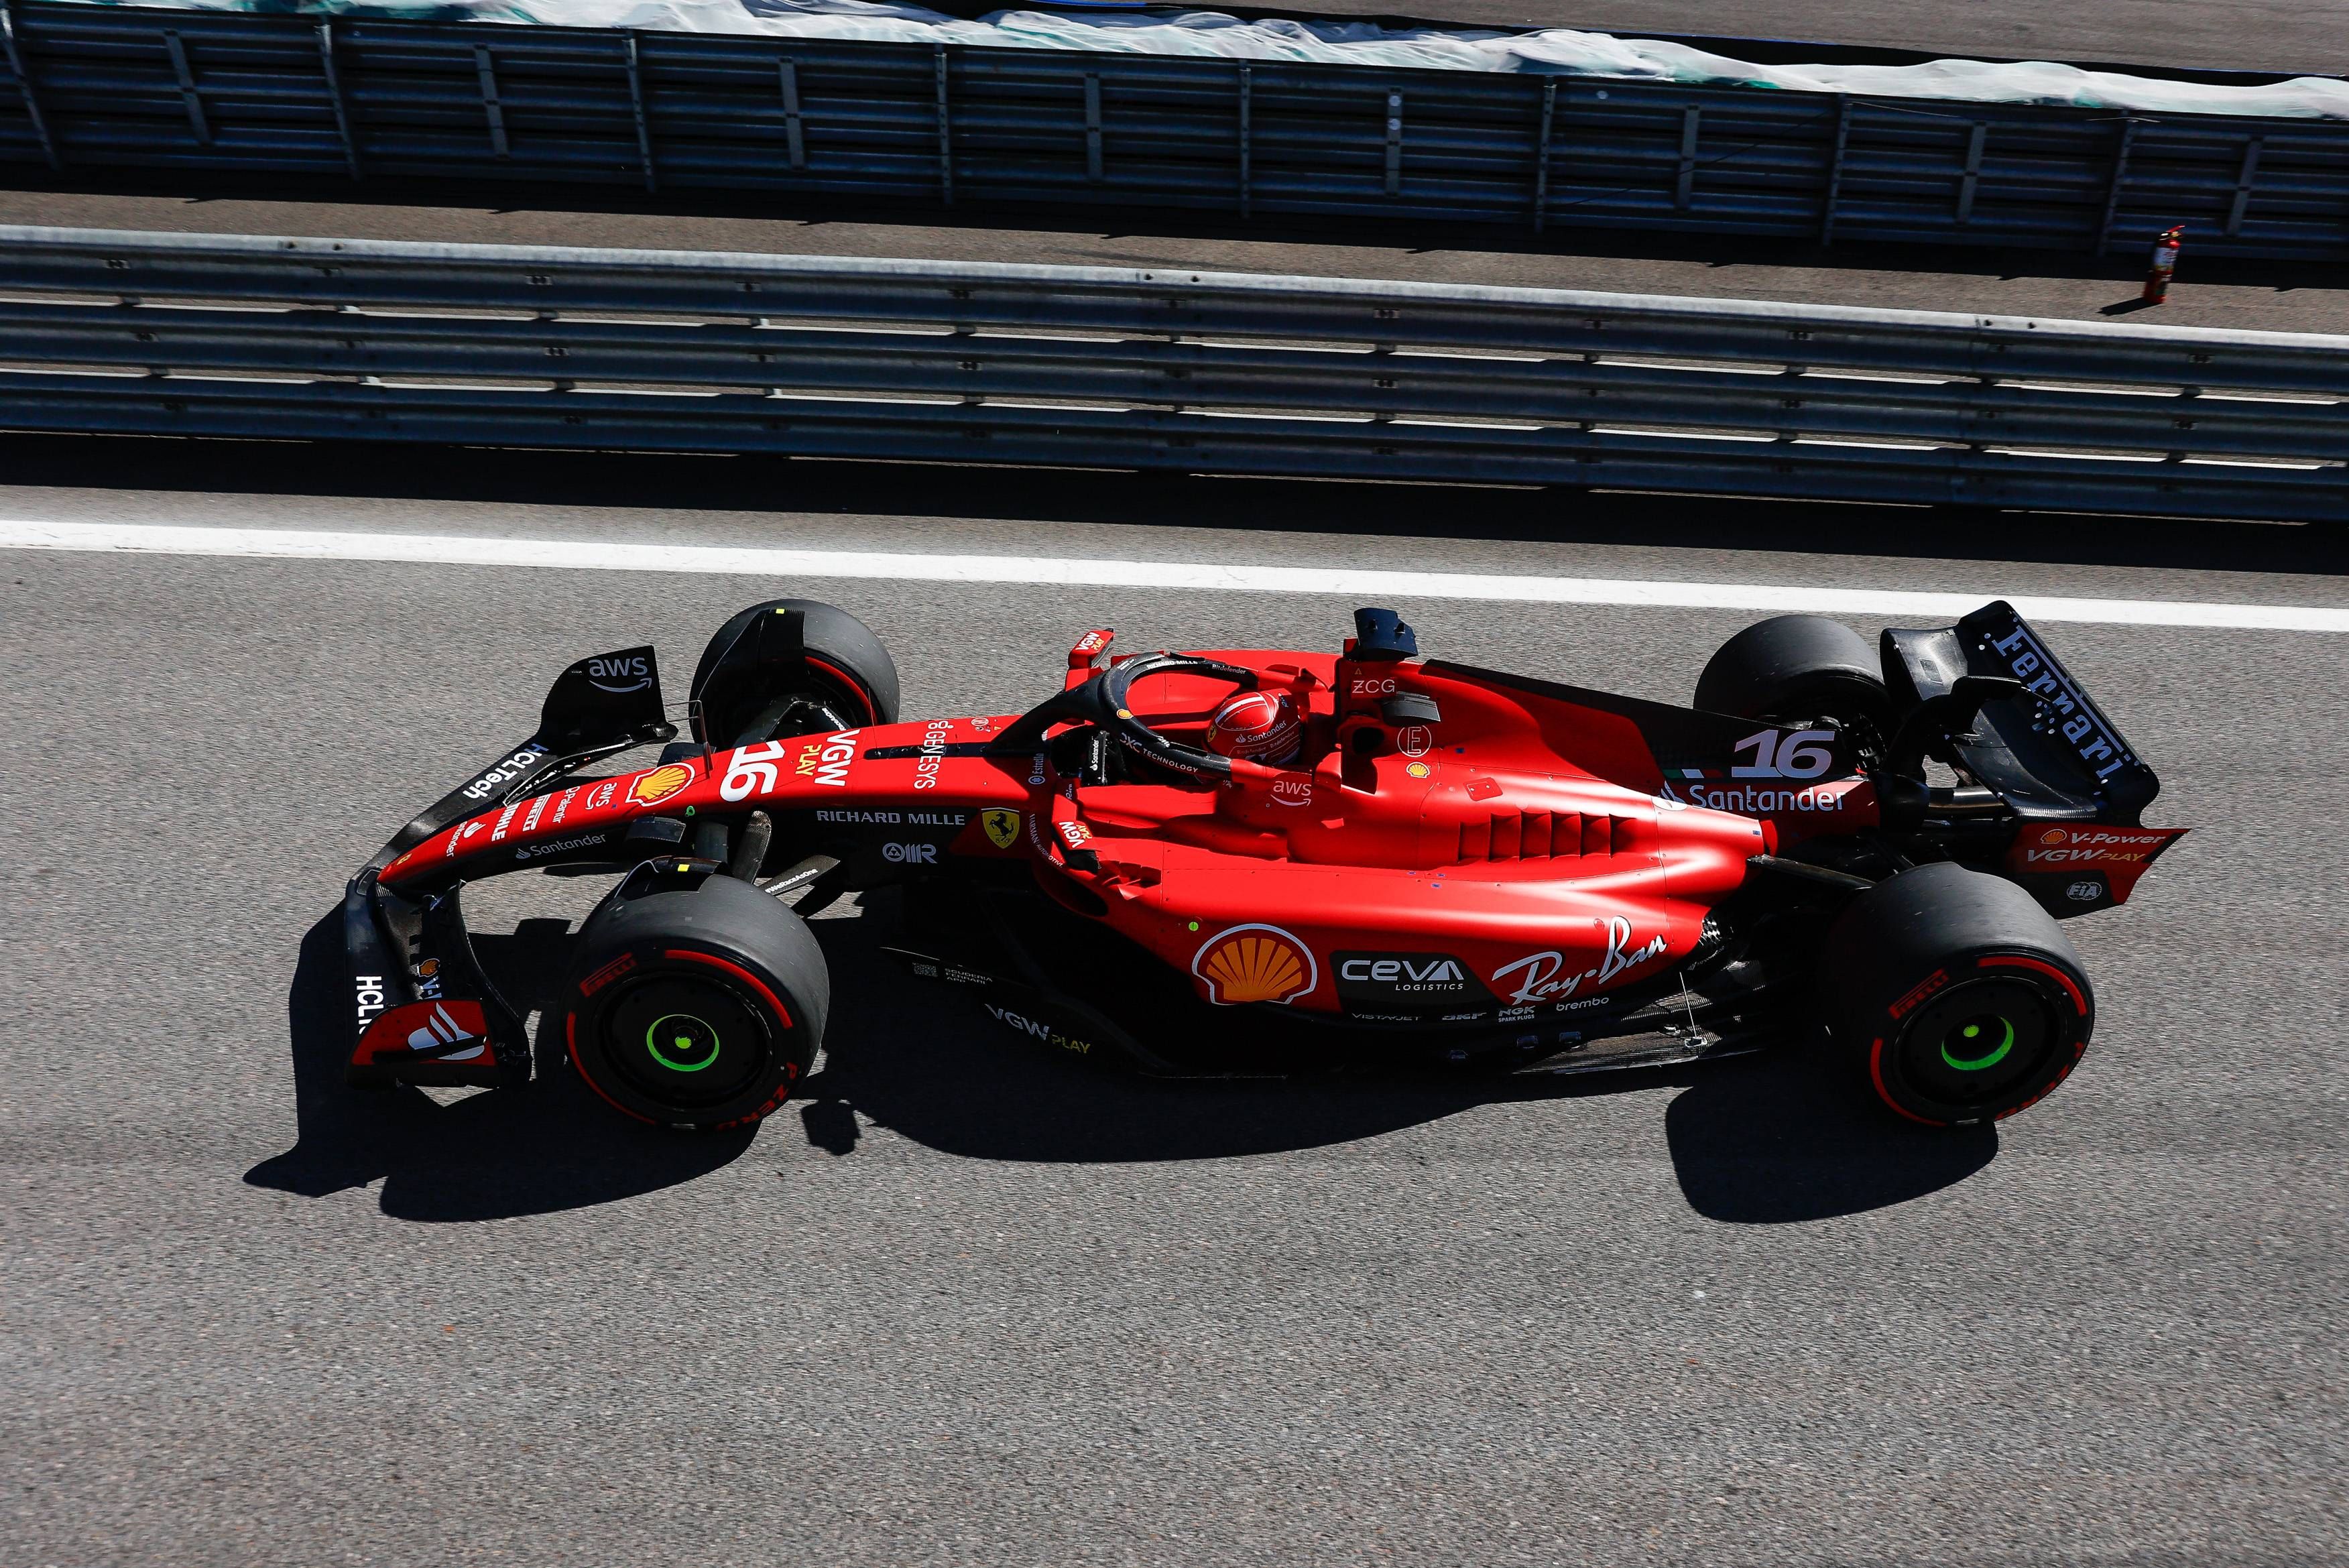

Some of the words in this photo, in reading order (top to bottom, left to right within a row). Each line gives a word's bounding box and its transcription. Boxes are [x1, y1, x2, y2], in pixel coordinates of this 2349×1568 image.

[1075, 632, 1099, 650] VGW
[588, 657, 648, 676] aws
[1211, 664, 1246, 674] Bitdefender
[1992, 625, 2132, 779] Ferrari
[1247, 720, 1287, 743] Santander
[795, 744, 823, 776] PLAY
[814, 729, 867, 786] VGW
[914, 731, 947, 789] GENESYS
[1091, 739, 1100, 764] Santander
[1143, 748, 1199, 773] TECHNOLOGY
[1731, 729, 1835, 778] 16
[463, 743, 550, 799] HCLTech
[719, 739, 786, 802] 16
[595, 782, 617, 807] aws
[1273, 780, 1313, 796] aws
[1689, 784, 1847, 812] Santander
[522, 793, 553, 832] PIRELLI
[552, 792, 576, 824] Palantir
[817, 810, 901, 824] RICHARD
[908, 813, 966, 825] MILLE
[1058, 821, 1085, 849] VGW
[1076, 824, 1093, 839] PLAY
[2071, 833, 2167, 844] V-Power
[530, 834, 606, 856] Santander
[2028, 849, 2106, 862] VGW
[2098, 853, 2147, 862] PLAY
[1492, 915, 1667, 1006] Ray-Ban
[1498, 1006, 1537, 1017] NGK
[1555, 996, 1610, 1012] brembo
[984, 1003, 1050, 1041] VGW
[1051, 1034, 1091, 1054] PLAY
